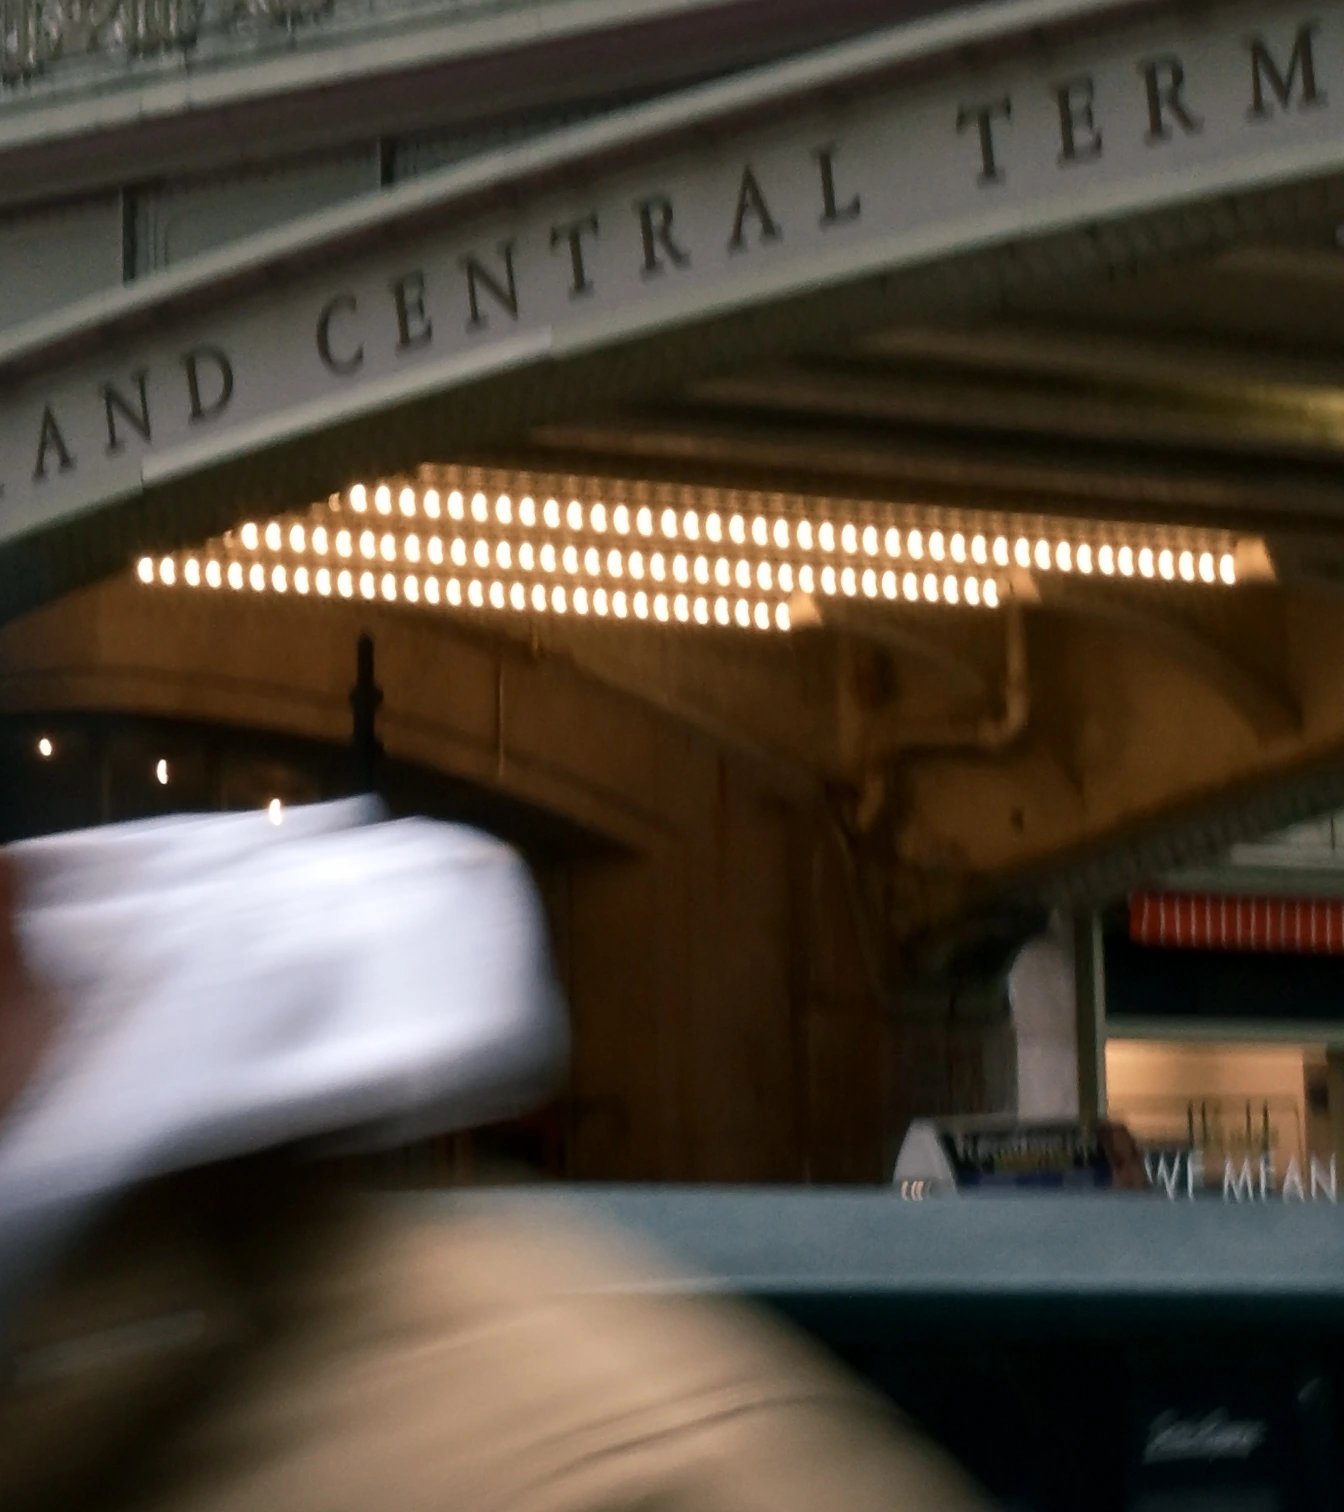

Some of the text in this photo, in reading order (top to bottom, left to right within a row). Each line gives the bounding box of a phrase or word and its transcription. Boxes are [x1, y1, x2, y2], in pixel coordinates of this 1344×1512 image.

[314, 138, 862, 376] CENTRAL
[954, 14, 1330, 190] TERM
[1222, 1149, 1338, 1205] MEAN
